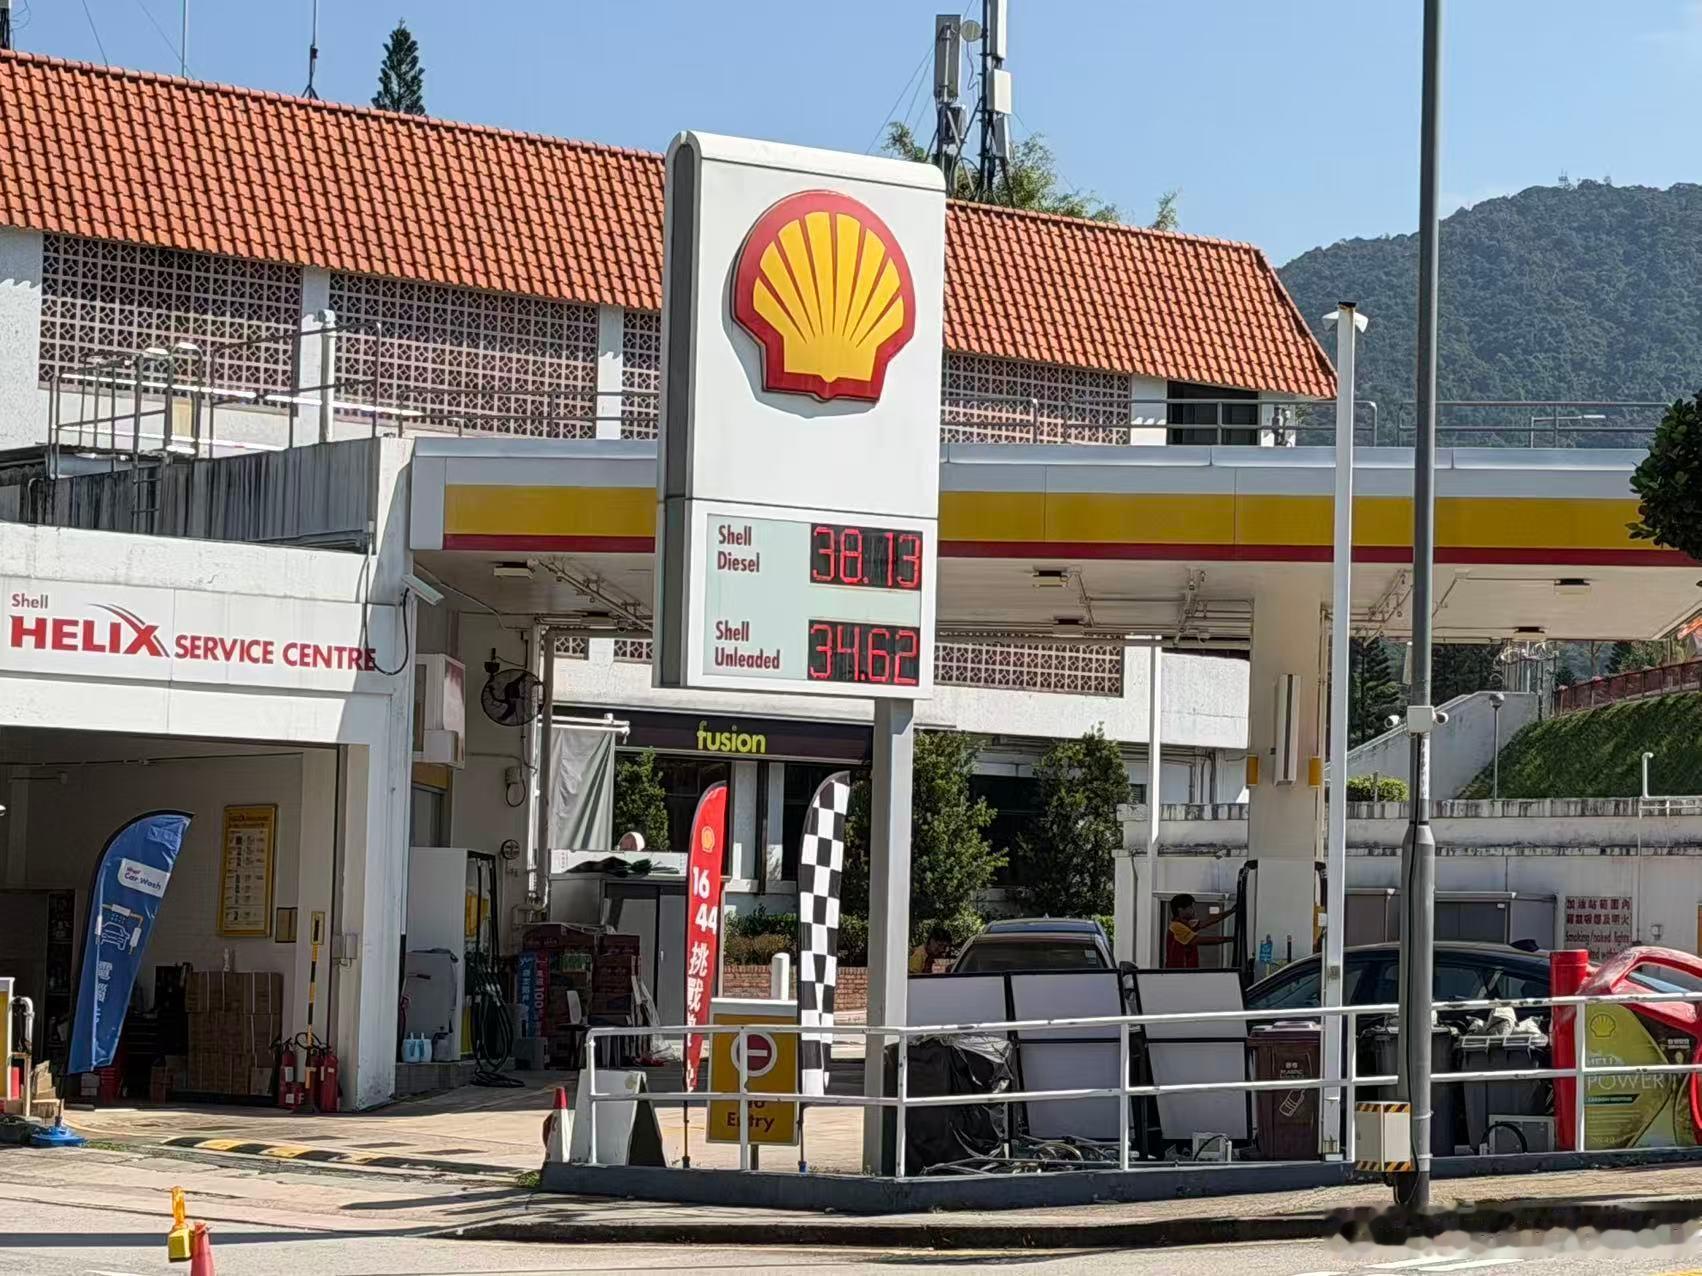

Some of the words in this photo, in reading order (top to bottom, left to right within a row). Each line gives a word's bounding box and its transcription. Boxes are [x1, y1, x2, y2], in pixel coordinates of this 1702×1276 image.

[718, 525, 752, 546] Shell
[717, 551, 760, 573] Diesel
[812, 526, 922, 588] 38.13
[11, 593, 49, 609] Shell
[10, 604, 170, 657] HELIX
[715, 620, 750, 642] Shell
[174, 634, 274, 665] SERVICE
[282, 642, 376, 672] CENTRE
[714, 647, 781, 669] Unleaded
[809, 624, 918, 684] 34.62
[696, 720, 766, 754] fusion
[124, 871, 139, 882] Car
[140, 876, 162, 891] Wash
[693, 866, 710, 899] 16
[695, 903, 718, 935] 44
[1588, 1072, 1664, 1090] POWER
